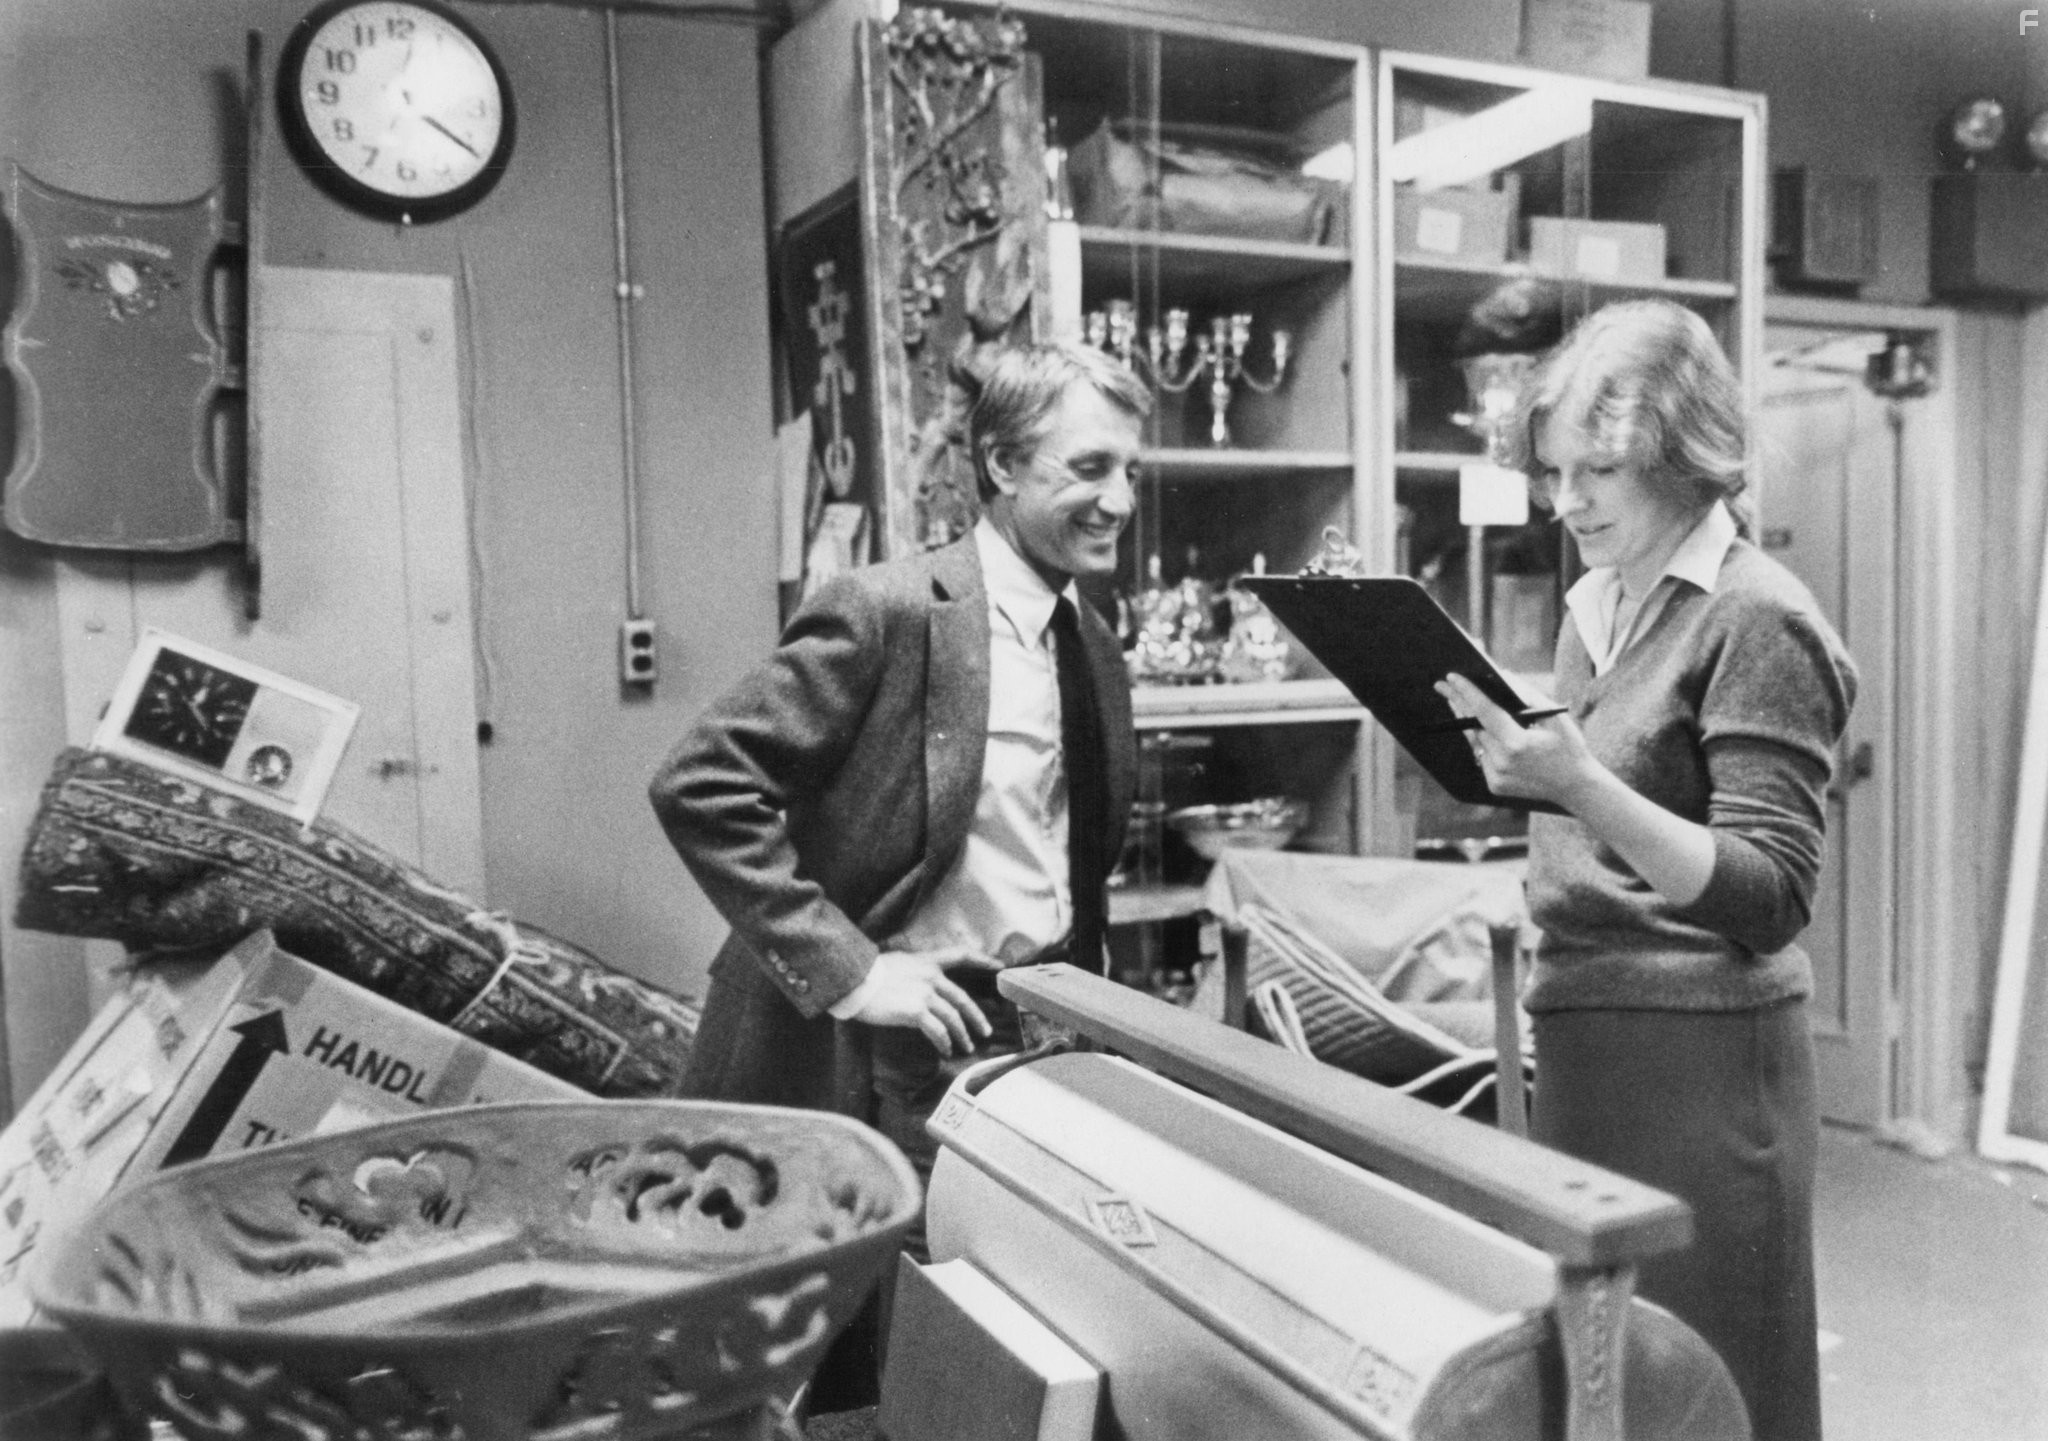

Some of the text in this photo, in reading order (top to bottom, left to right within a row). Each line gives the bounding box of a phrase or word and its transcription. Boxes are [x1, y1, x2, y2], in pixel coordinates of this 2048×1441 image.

[354, 22, 375, 47] 11
[386, 18, 415, 40] 12
[325, 48, 357, 74] 10
[316, 79, 340, 106] 9
[333, 117, 354, 142] 8
[362, 144, 380, 168] 7
[396, 160, 418, 182] 6
[303, 1026, 428, 1105] HANDL
